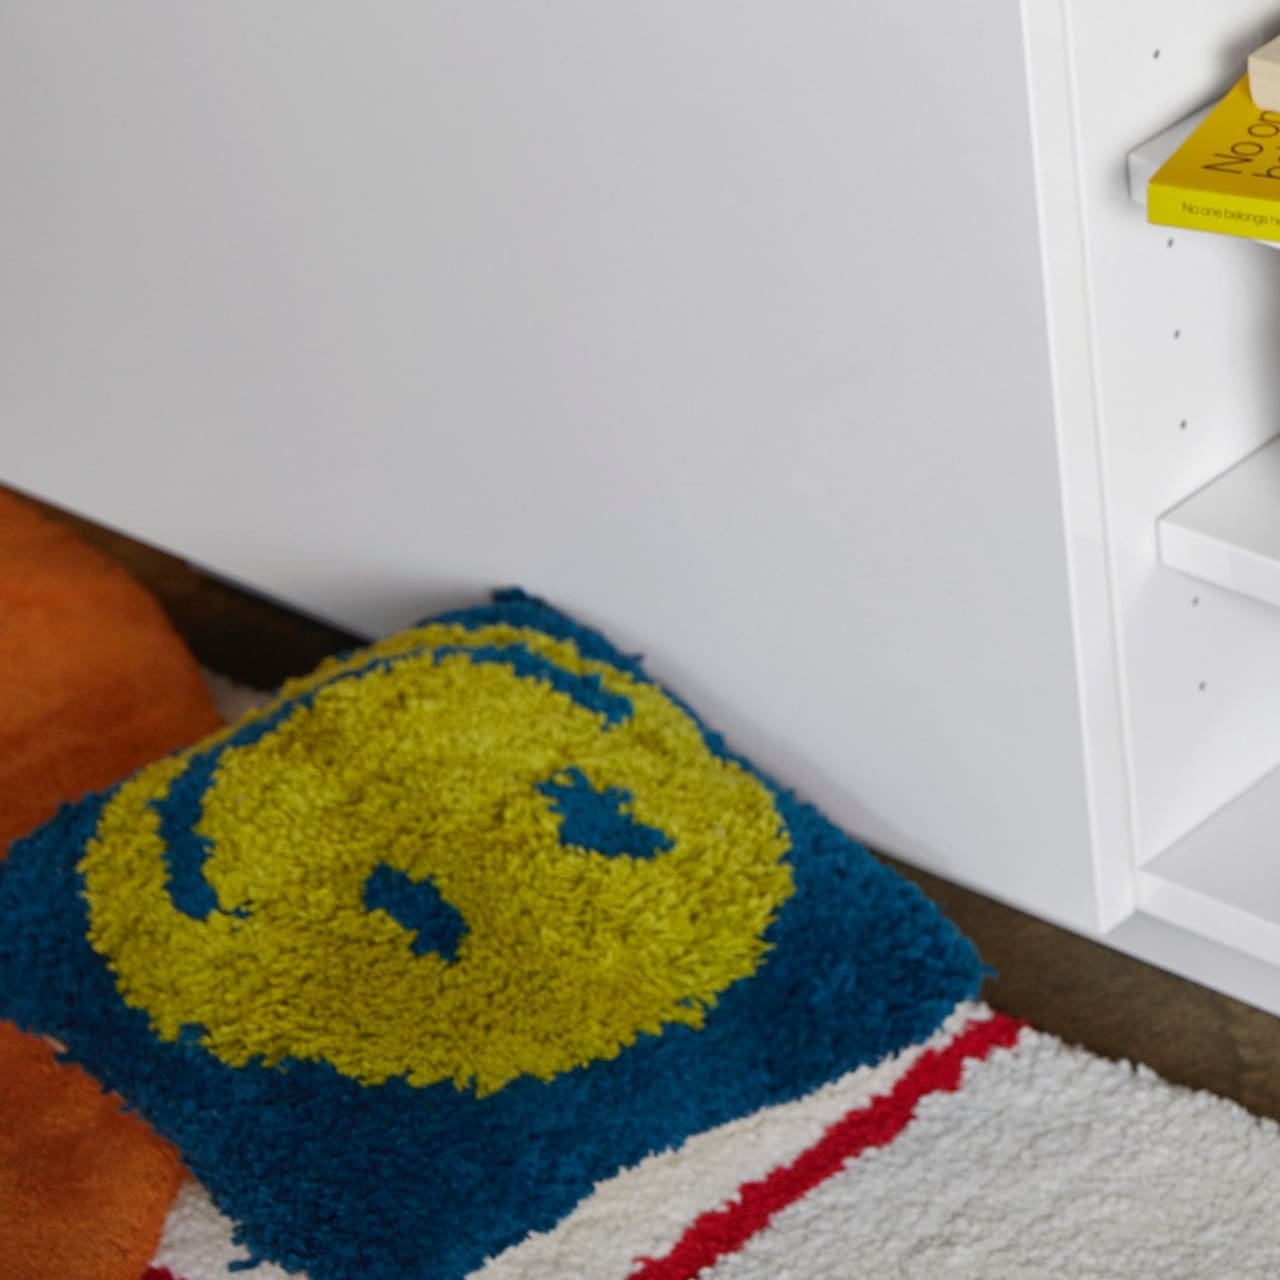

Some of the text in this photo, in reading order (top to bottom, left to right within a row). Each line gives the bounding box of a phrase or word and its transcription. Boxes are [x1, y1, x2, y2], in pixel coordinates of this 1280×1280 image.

[1202, 140, 1264, 175] No
[1181, 201, 1199, 215] No
[1200, 205, 1223, 219] one
[1223, 207, 1269, 227] belongs
